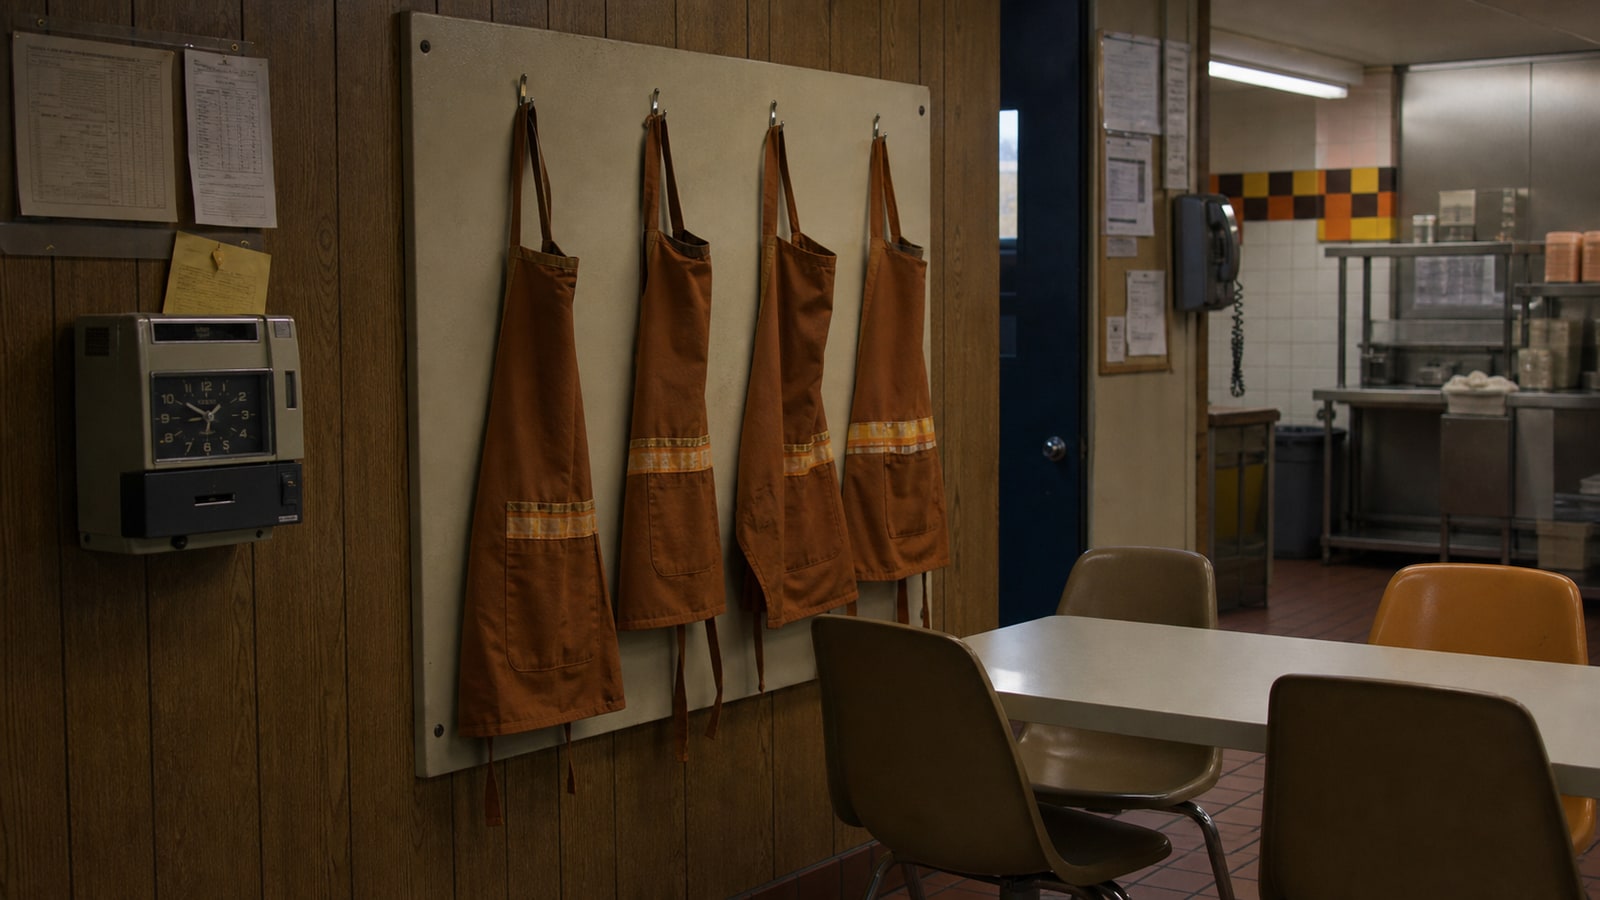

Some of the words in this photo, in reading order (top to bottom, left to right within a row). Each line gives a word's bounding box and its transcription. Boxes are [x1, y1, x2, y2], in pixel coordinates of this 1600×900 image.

[201, 381, 212, 392] 12
[161, 393, 174, 405] 10
[238, 391, 247, 402] 2
[160, 413, 170, 424] 9
[241, 410, 249, 420] 3
[165, 432, 174, 443] 8
[239, 428, 247, 438] 4
[185, 441, 192, 452] 7
[203, 442, 212, 452] 6
